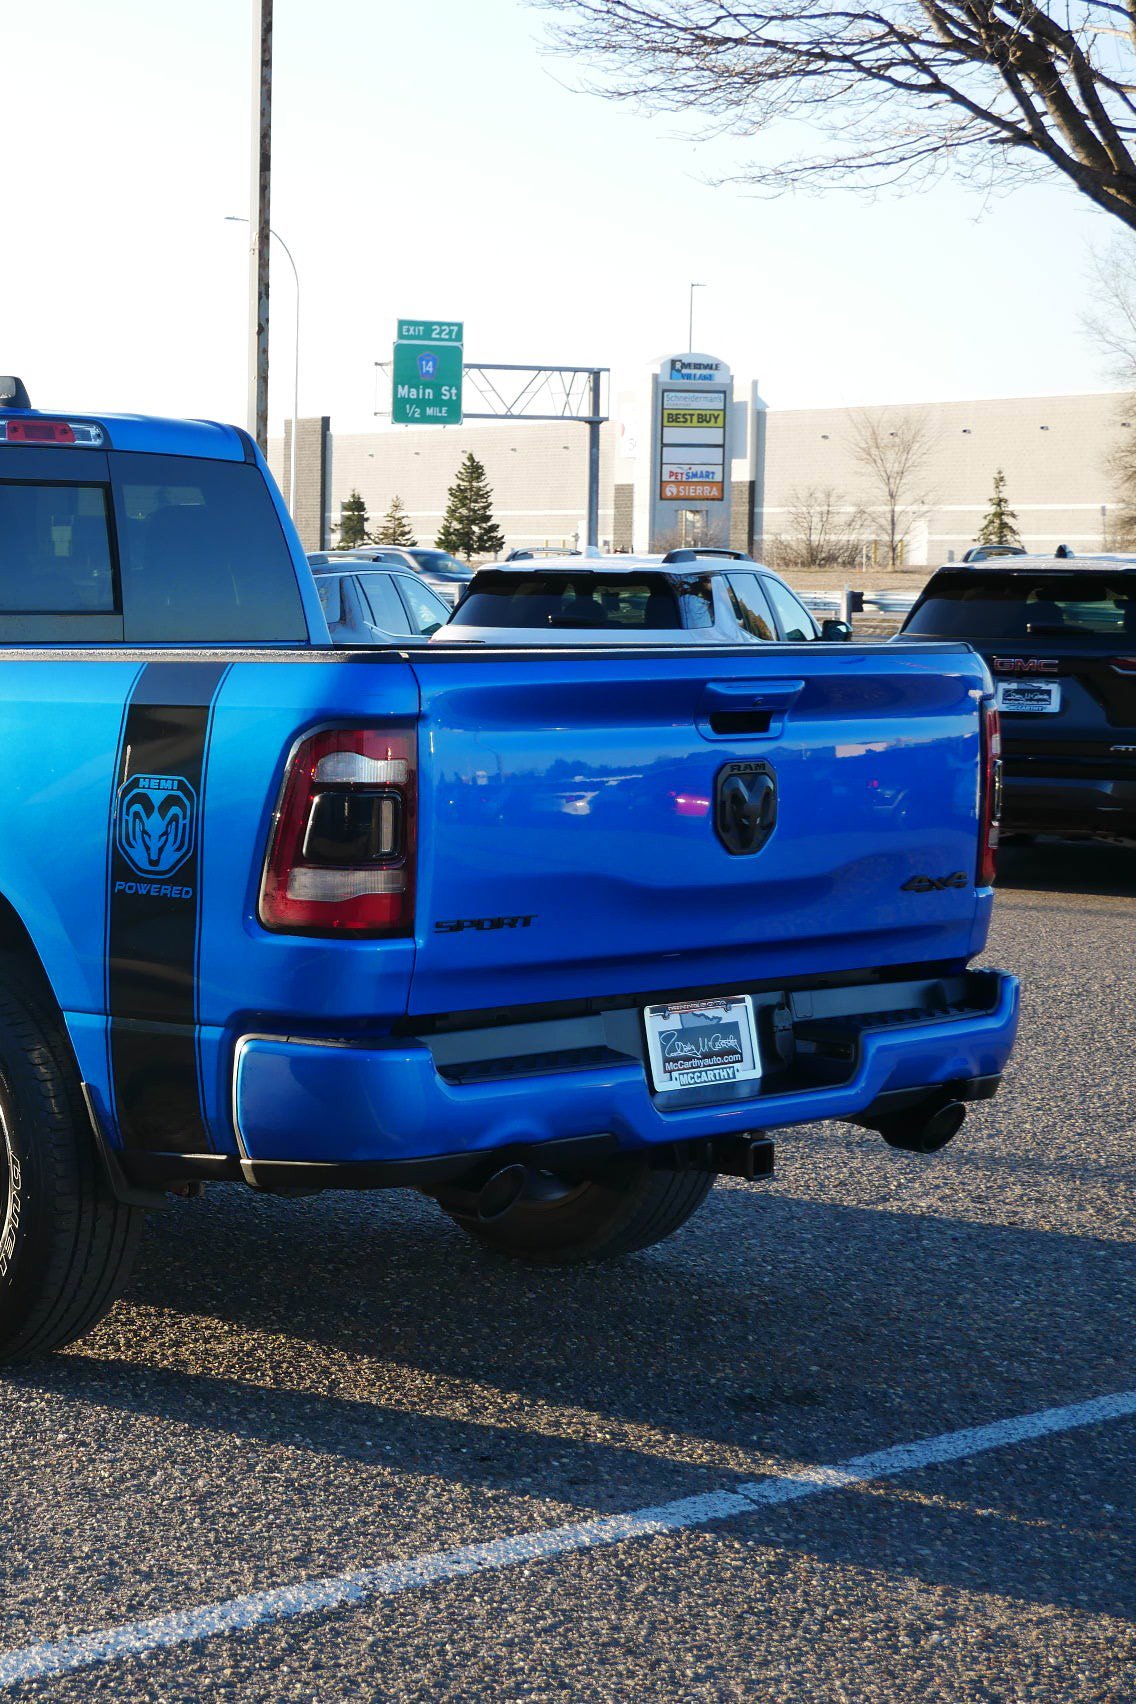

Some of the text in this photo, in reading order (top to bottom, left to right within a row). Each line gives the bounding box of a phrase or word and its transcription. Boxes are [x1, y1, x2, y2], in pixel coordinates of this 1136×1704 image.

[402, 325, 458, 339] EXIT 227
[422, 360, 433, 374] 14
[397, 384, 457, 400] Main St
[426, 406, 448, 417] MILE
[666, 412, 721, 424] BEST BUY
[679, 485, 718, 496] SIERRA
[994, 658, 1059, 672] GMC
[729, 763, 767, 773] RAM
[138, 778, 179, 790] HEMI
[114, 881, 193, 899] POWERED
[432, 913, 540, 934] SPORT
[665, 1053, 742, 1071] McCarthyauto.com
[679, 1067, 735, 1085] MCCARTHY
